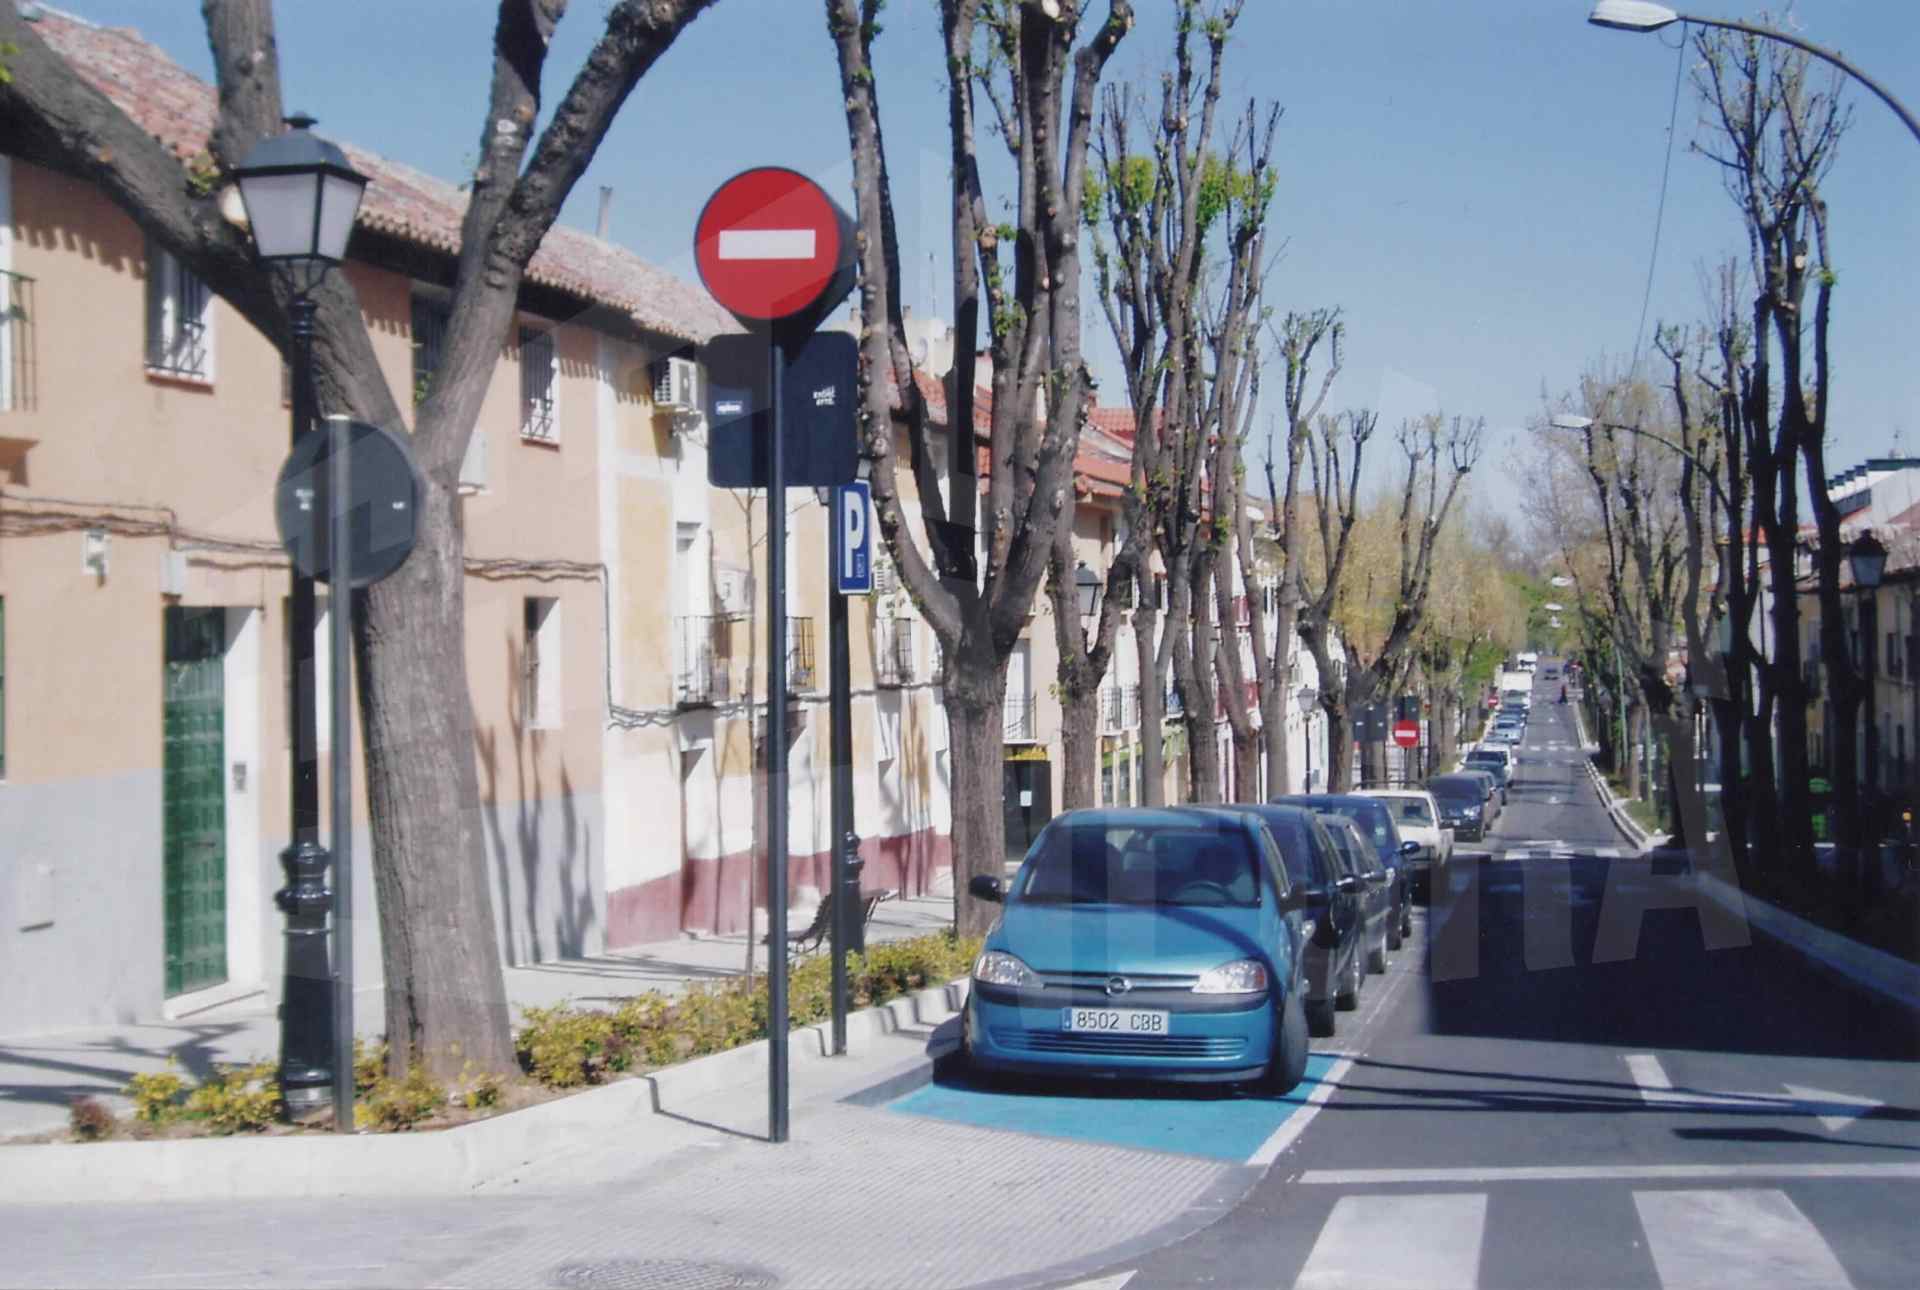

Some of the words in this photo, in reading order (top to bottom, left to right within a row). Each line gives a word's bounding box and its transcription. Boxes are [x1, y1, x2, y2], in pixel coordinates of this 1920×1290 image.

[844, 491, 865, 578] P
[1076, 1011, 1120, 1030] 8502
[1130, 1013, 1162, 1031] CBB
